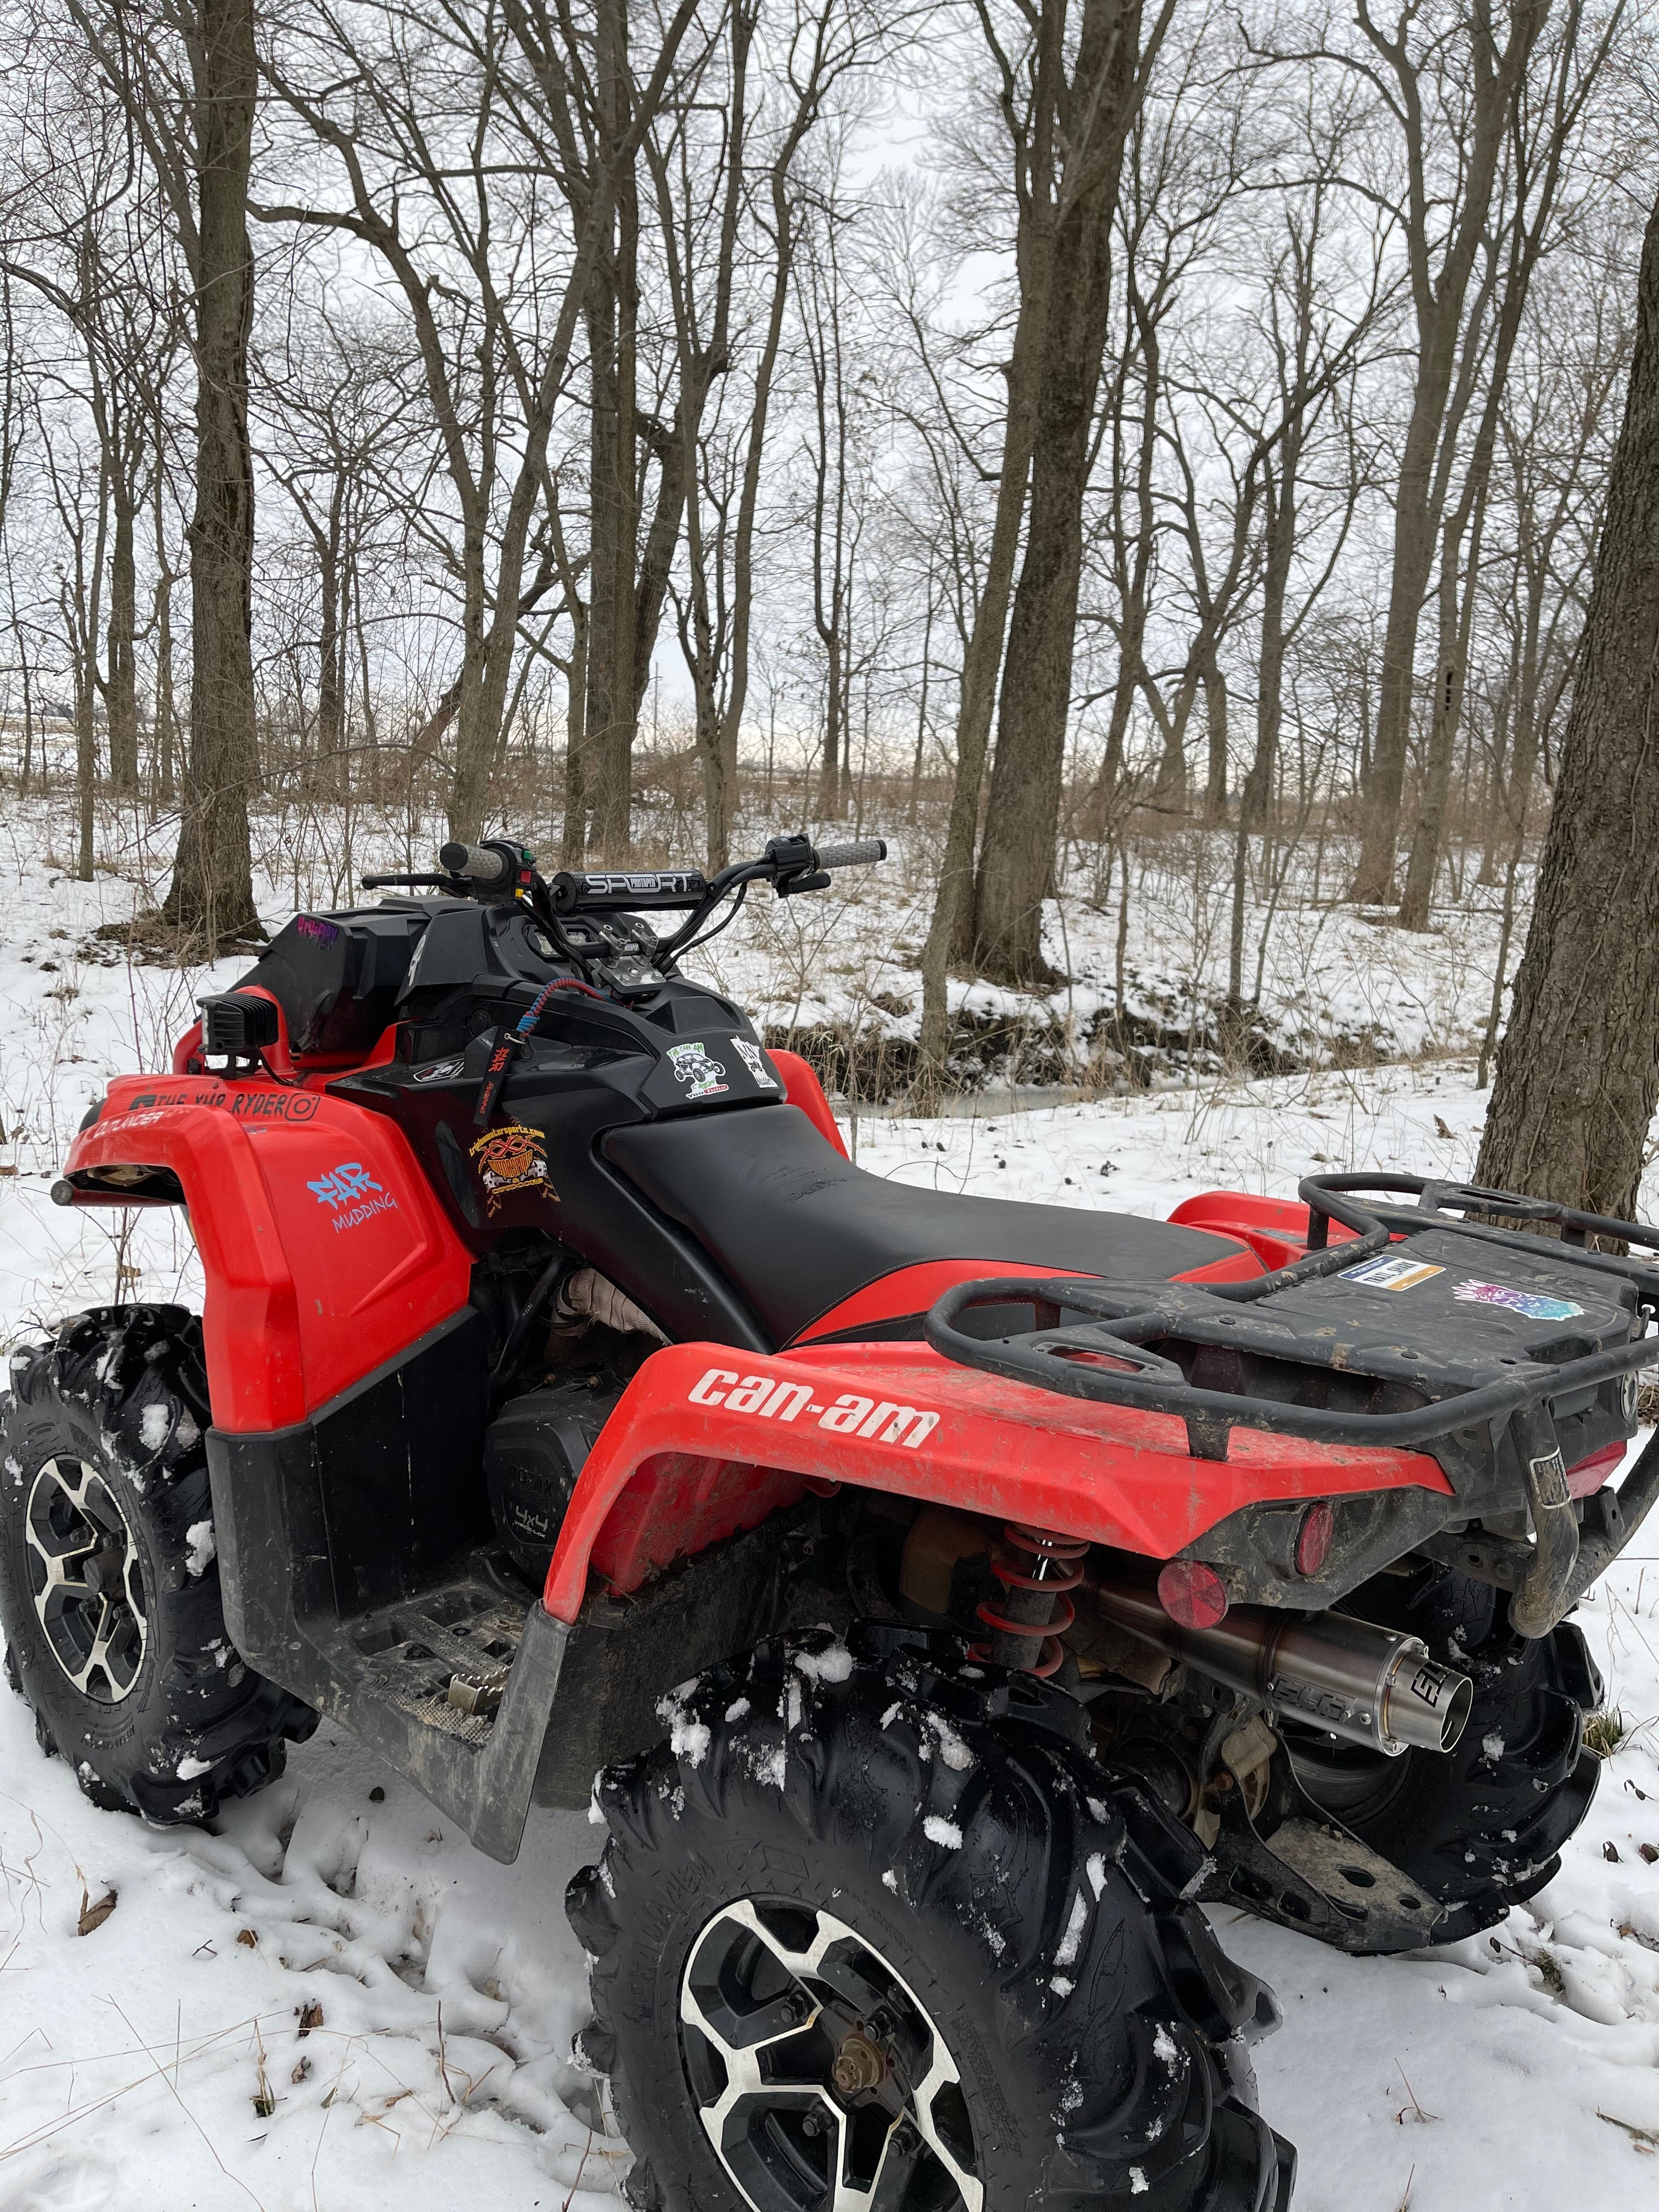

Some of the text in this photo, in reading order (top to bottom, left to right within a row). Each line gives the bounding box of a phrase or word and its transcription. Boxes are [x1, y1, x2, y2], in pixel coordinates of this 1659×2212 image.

[585, 873, 692, 894] SPORT
[630, 878, 657, 889] PROTAPER
[692, 1079, 715, 1090] CREW
[331, 1192, 399, 1234] MUDDING
[688, 1368, 941, 1449] can-am
[515, 1505, 549, 1532] 4x4
